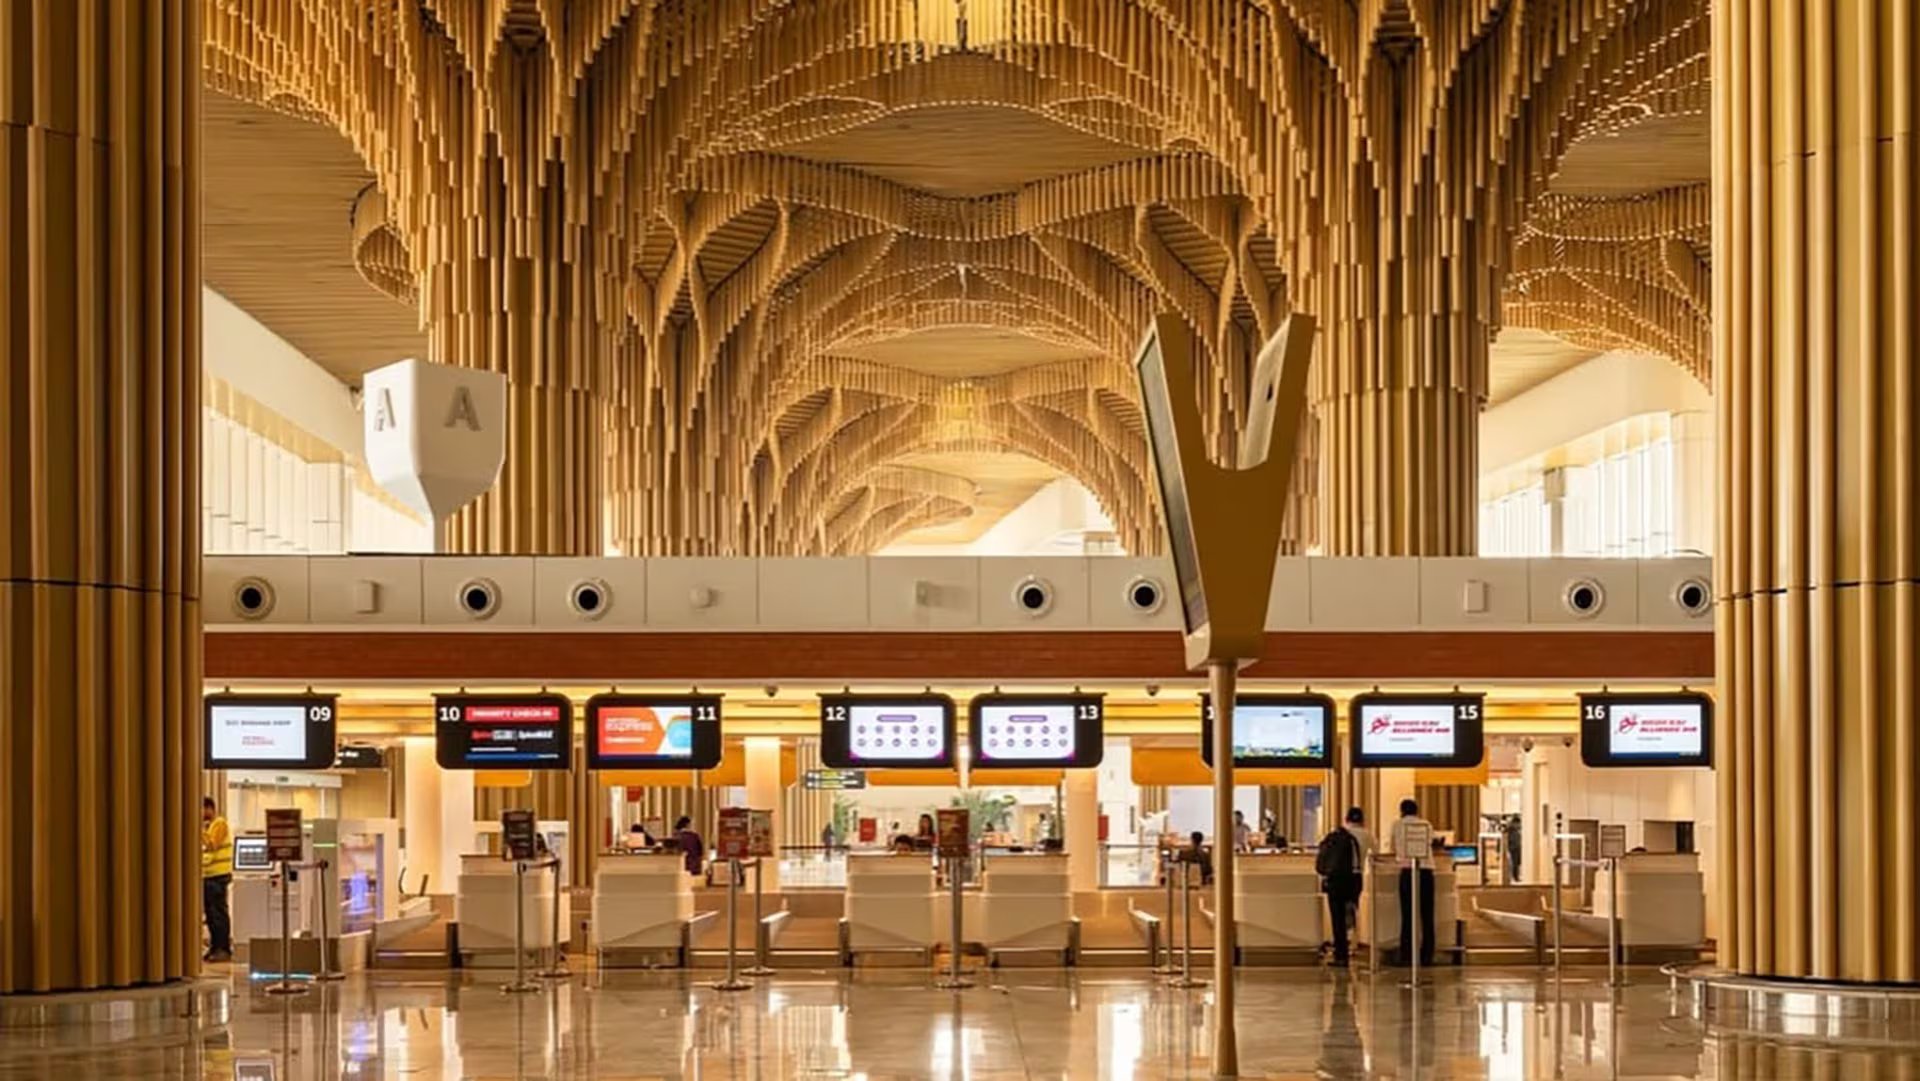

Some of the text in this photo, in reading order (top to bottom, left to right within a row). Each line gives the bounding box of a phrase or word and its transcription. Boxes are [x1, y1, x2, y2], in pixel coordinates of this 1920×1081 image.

[374, 387, 396, 432] A
[443, 386, 483, 432] A
[310, 706, 331, 721] 09
[440, 706, 460, 721] 10
[697, 706, 717, 720] 11
[825, 706, 846, 721] 12
[1079, 705, 1098, 720] 13
[1458, 705, 1478, 720] 15
[1585, 705, 1605, 720] 16
